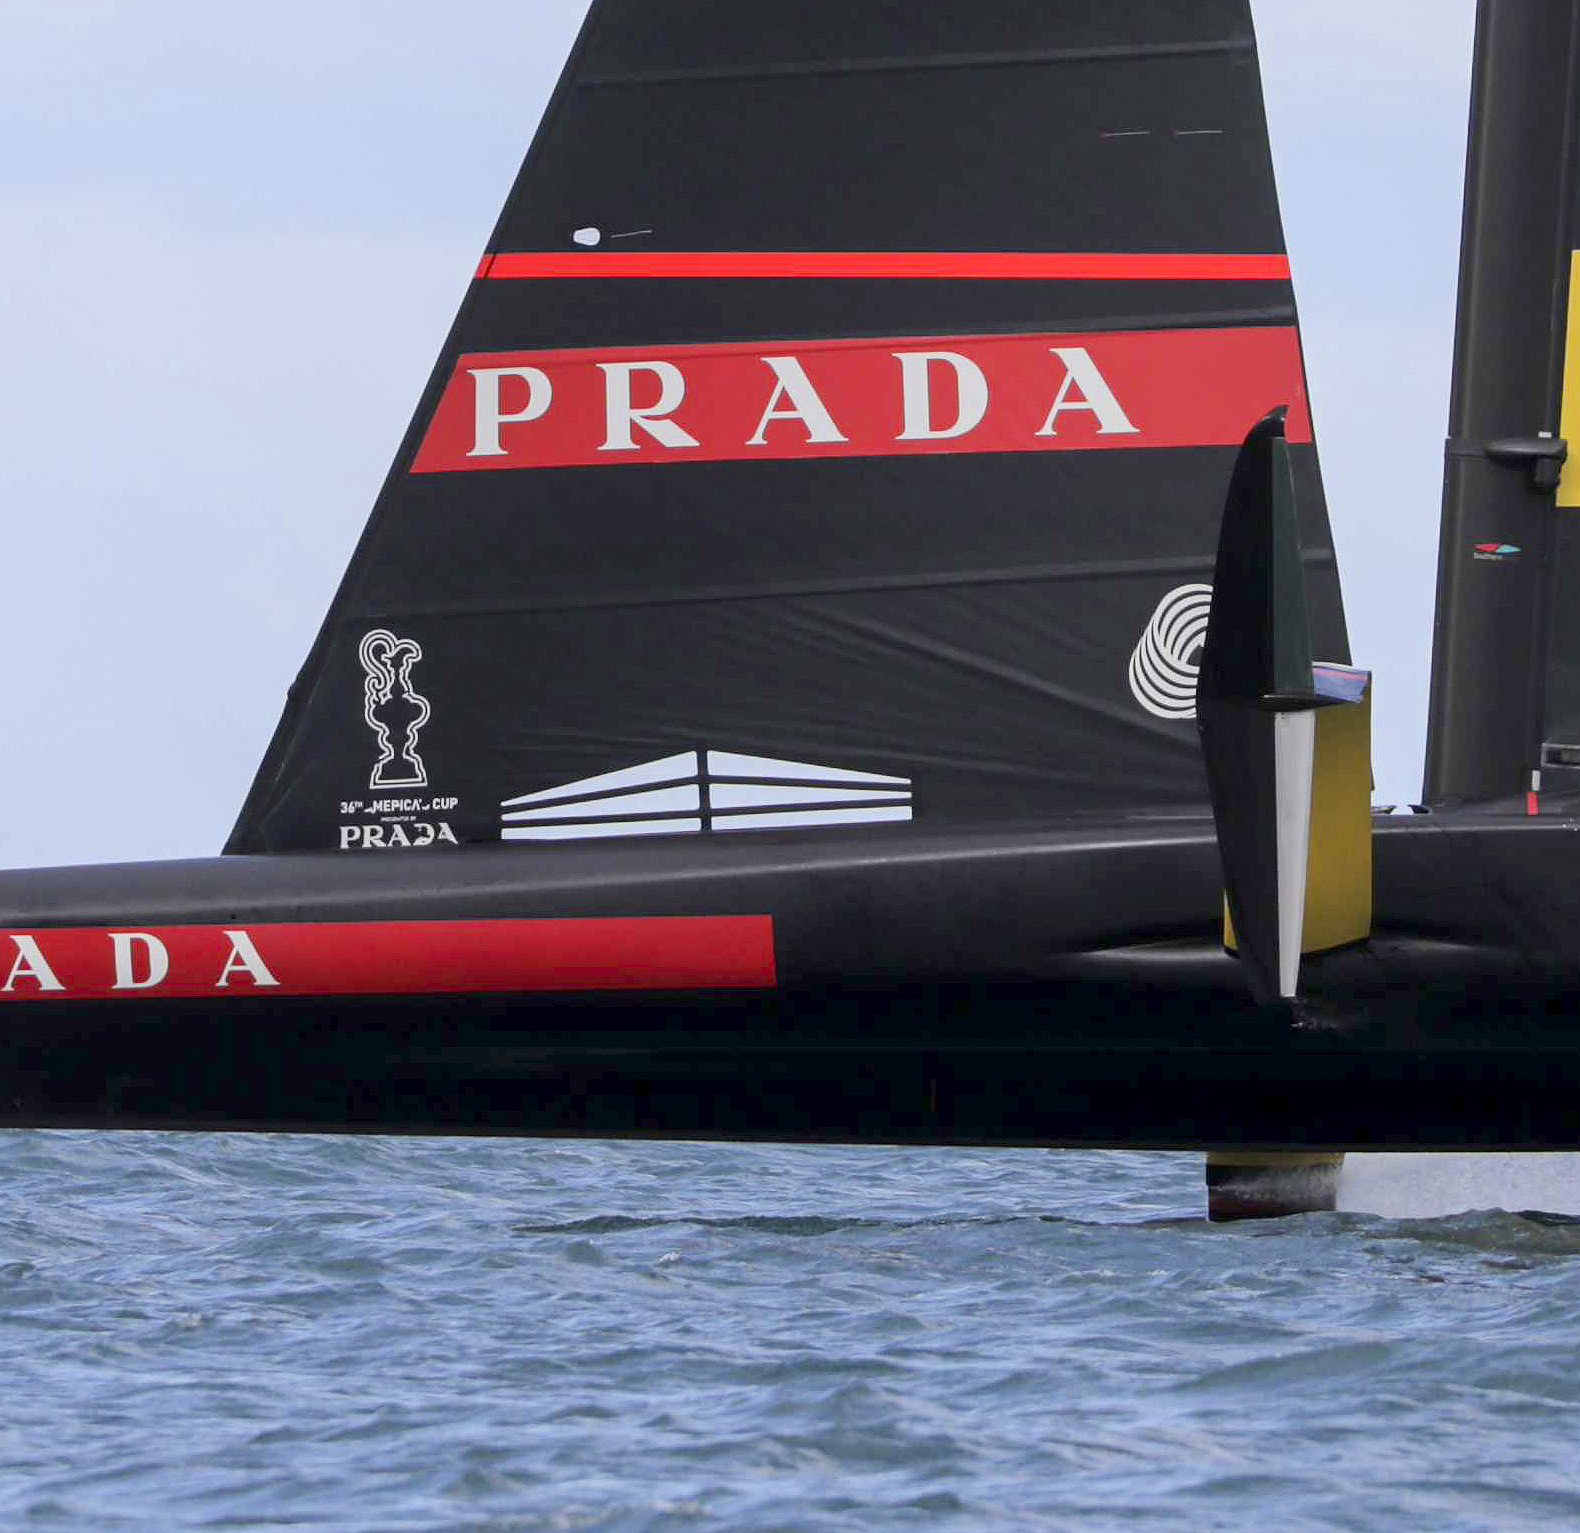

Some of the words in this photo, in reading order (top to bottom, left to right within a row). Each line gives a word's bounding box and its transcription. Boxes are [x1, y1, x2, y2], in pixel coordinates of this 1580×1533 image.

[466, 347, 1140, 456] PRADA
[432, 797, 459, 811] CUP
[339, 822, 459, 849] PRADA
